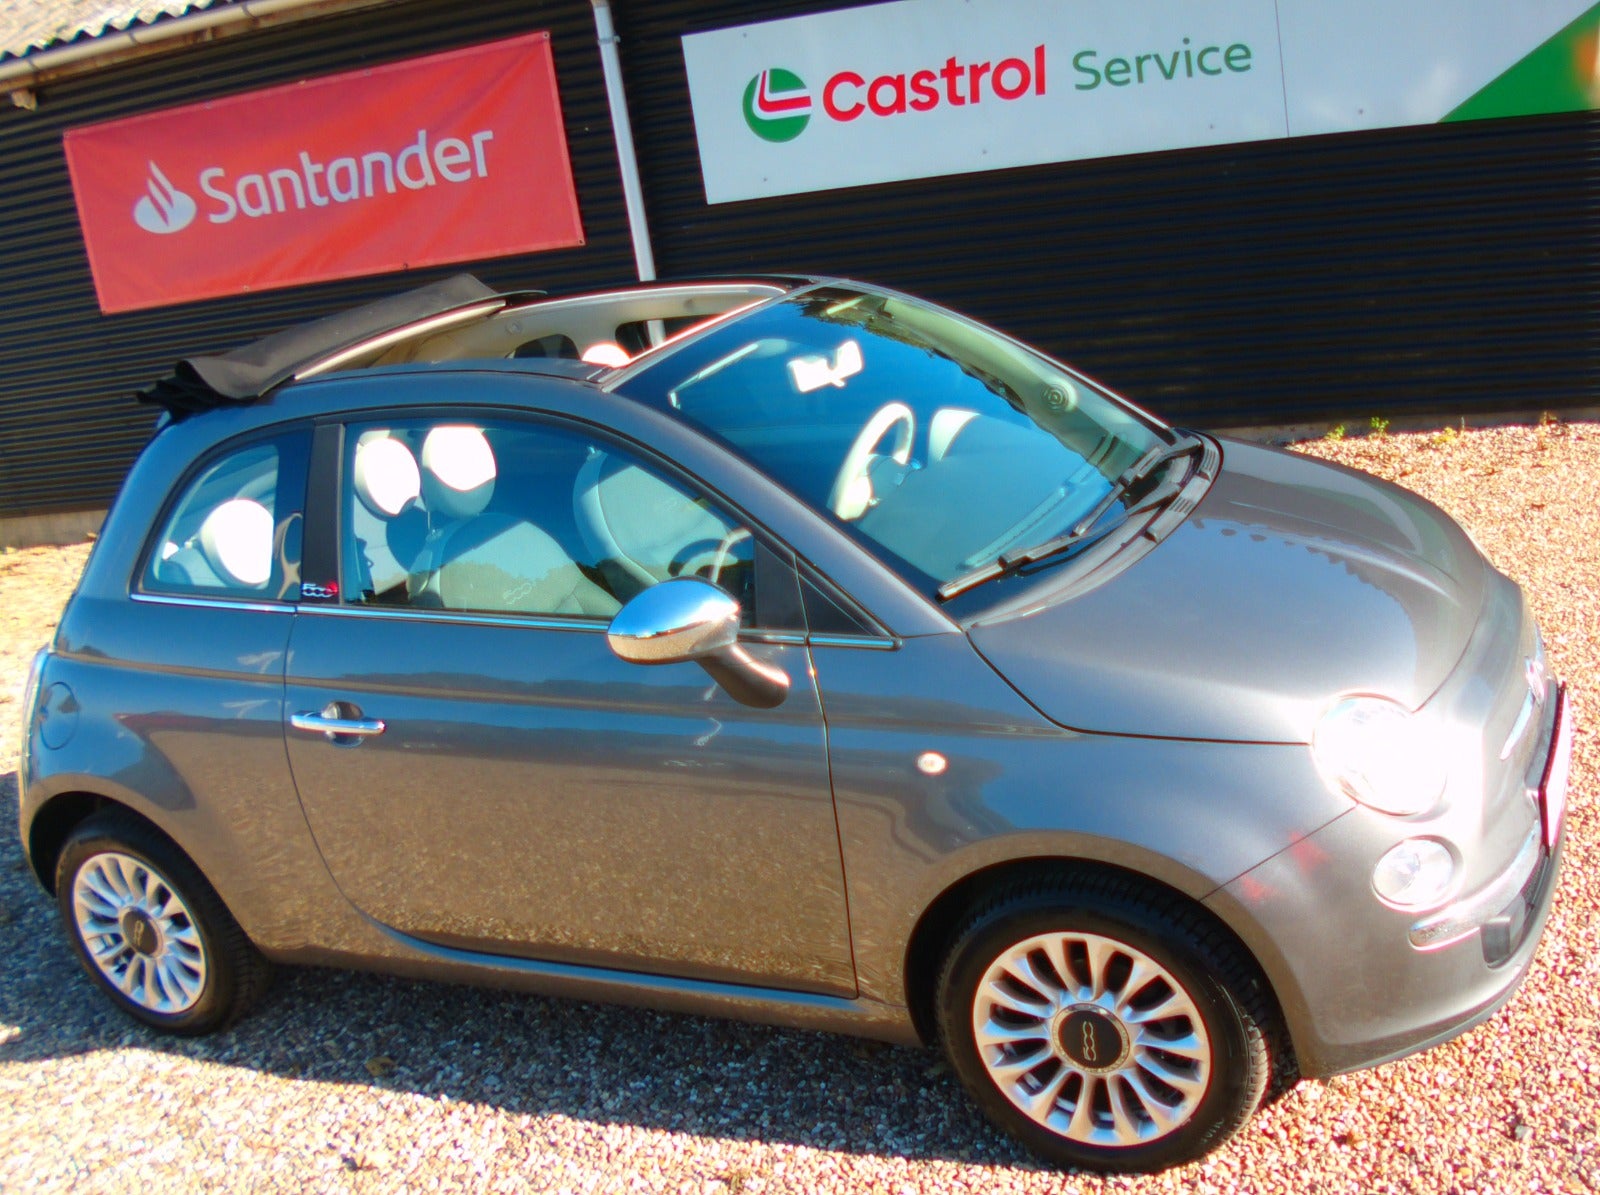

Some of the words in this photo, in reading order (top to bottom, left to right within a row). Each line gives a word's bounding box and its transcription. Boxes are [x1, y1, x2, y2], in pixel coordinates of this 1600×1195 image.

[823, 44, 1047, 122] Castrol
[1073, 37, 1253, 91] Service
[200, 129, 494, 224] Santander
